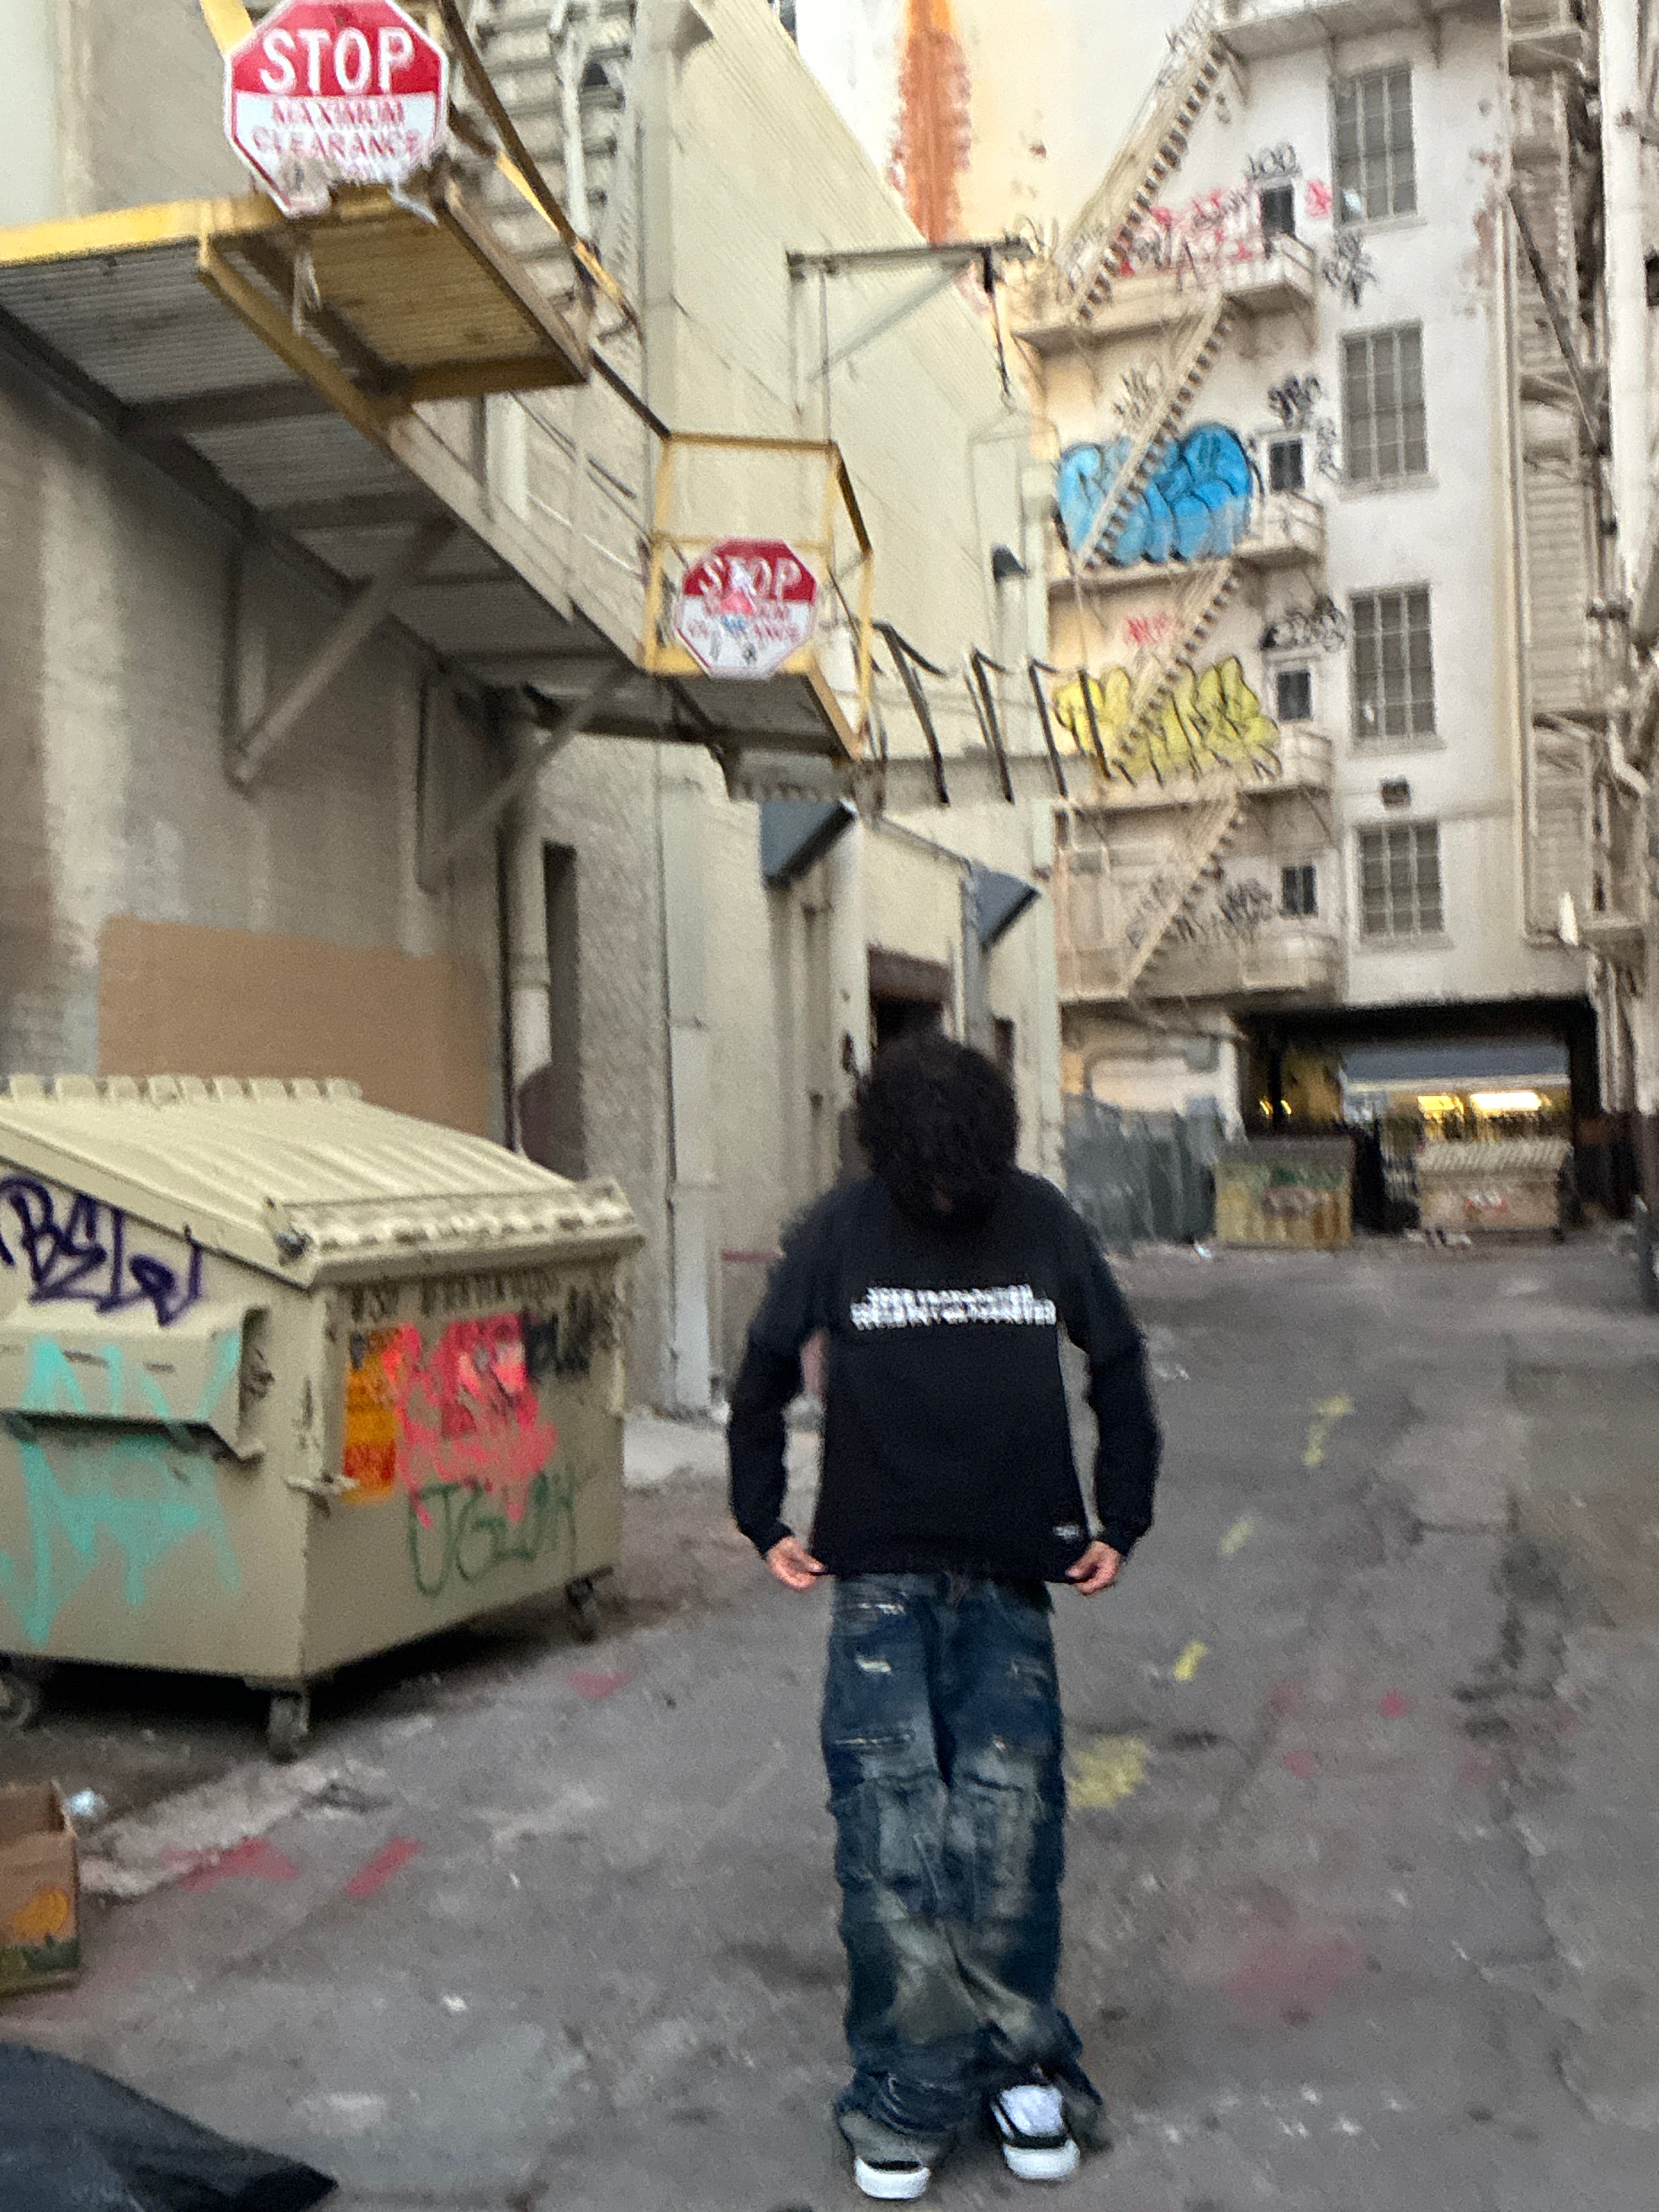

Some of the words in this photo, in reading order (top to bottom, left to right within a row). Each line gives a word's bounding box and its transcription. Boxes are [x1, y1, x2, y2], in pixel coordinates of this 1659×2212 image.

[259, 26, 415, 95] STOP
[272, 100, 405, 127] MAXIMUM
[250, 125, 422, 160] CLEARANCE
